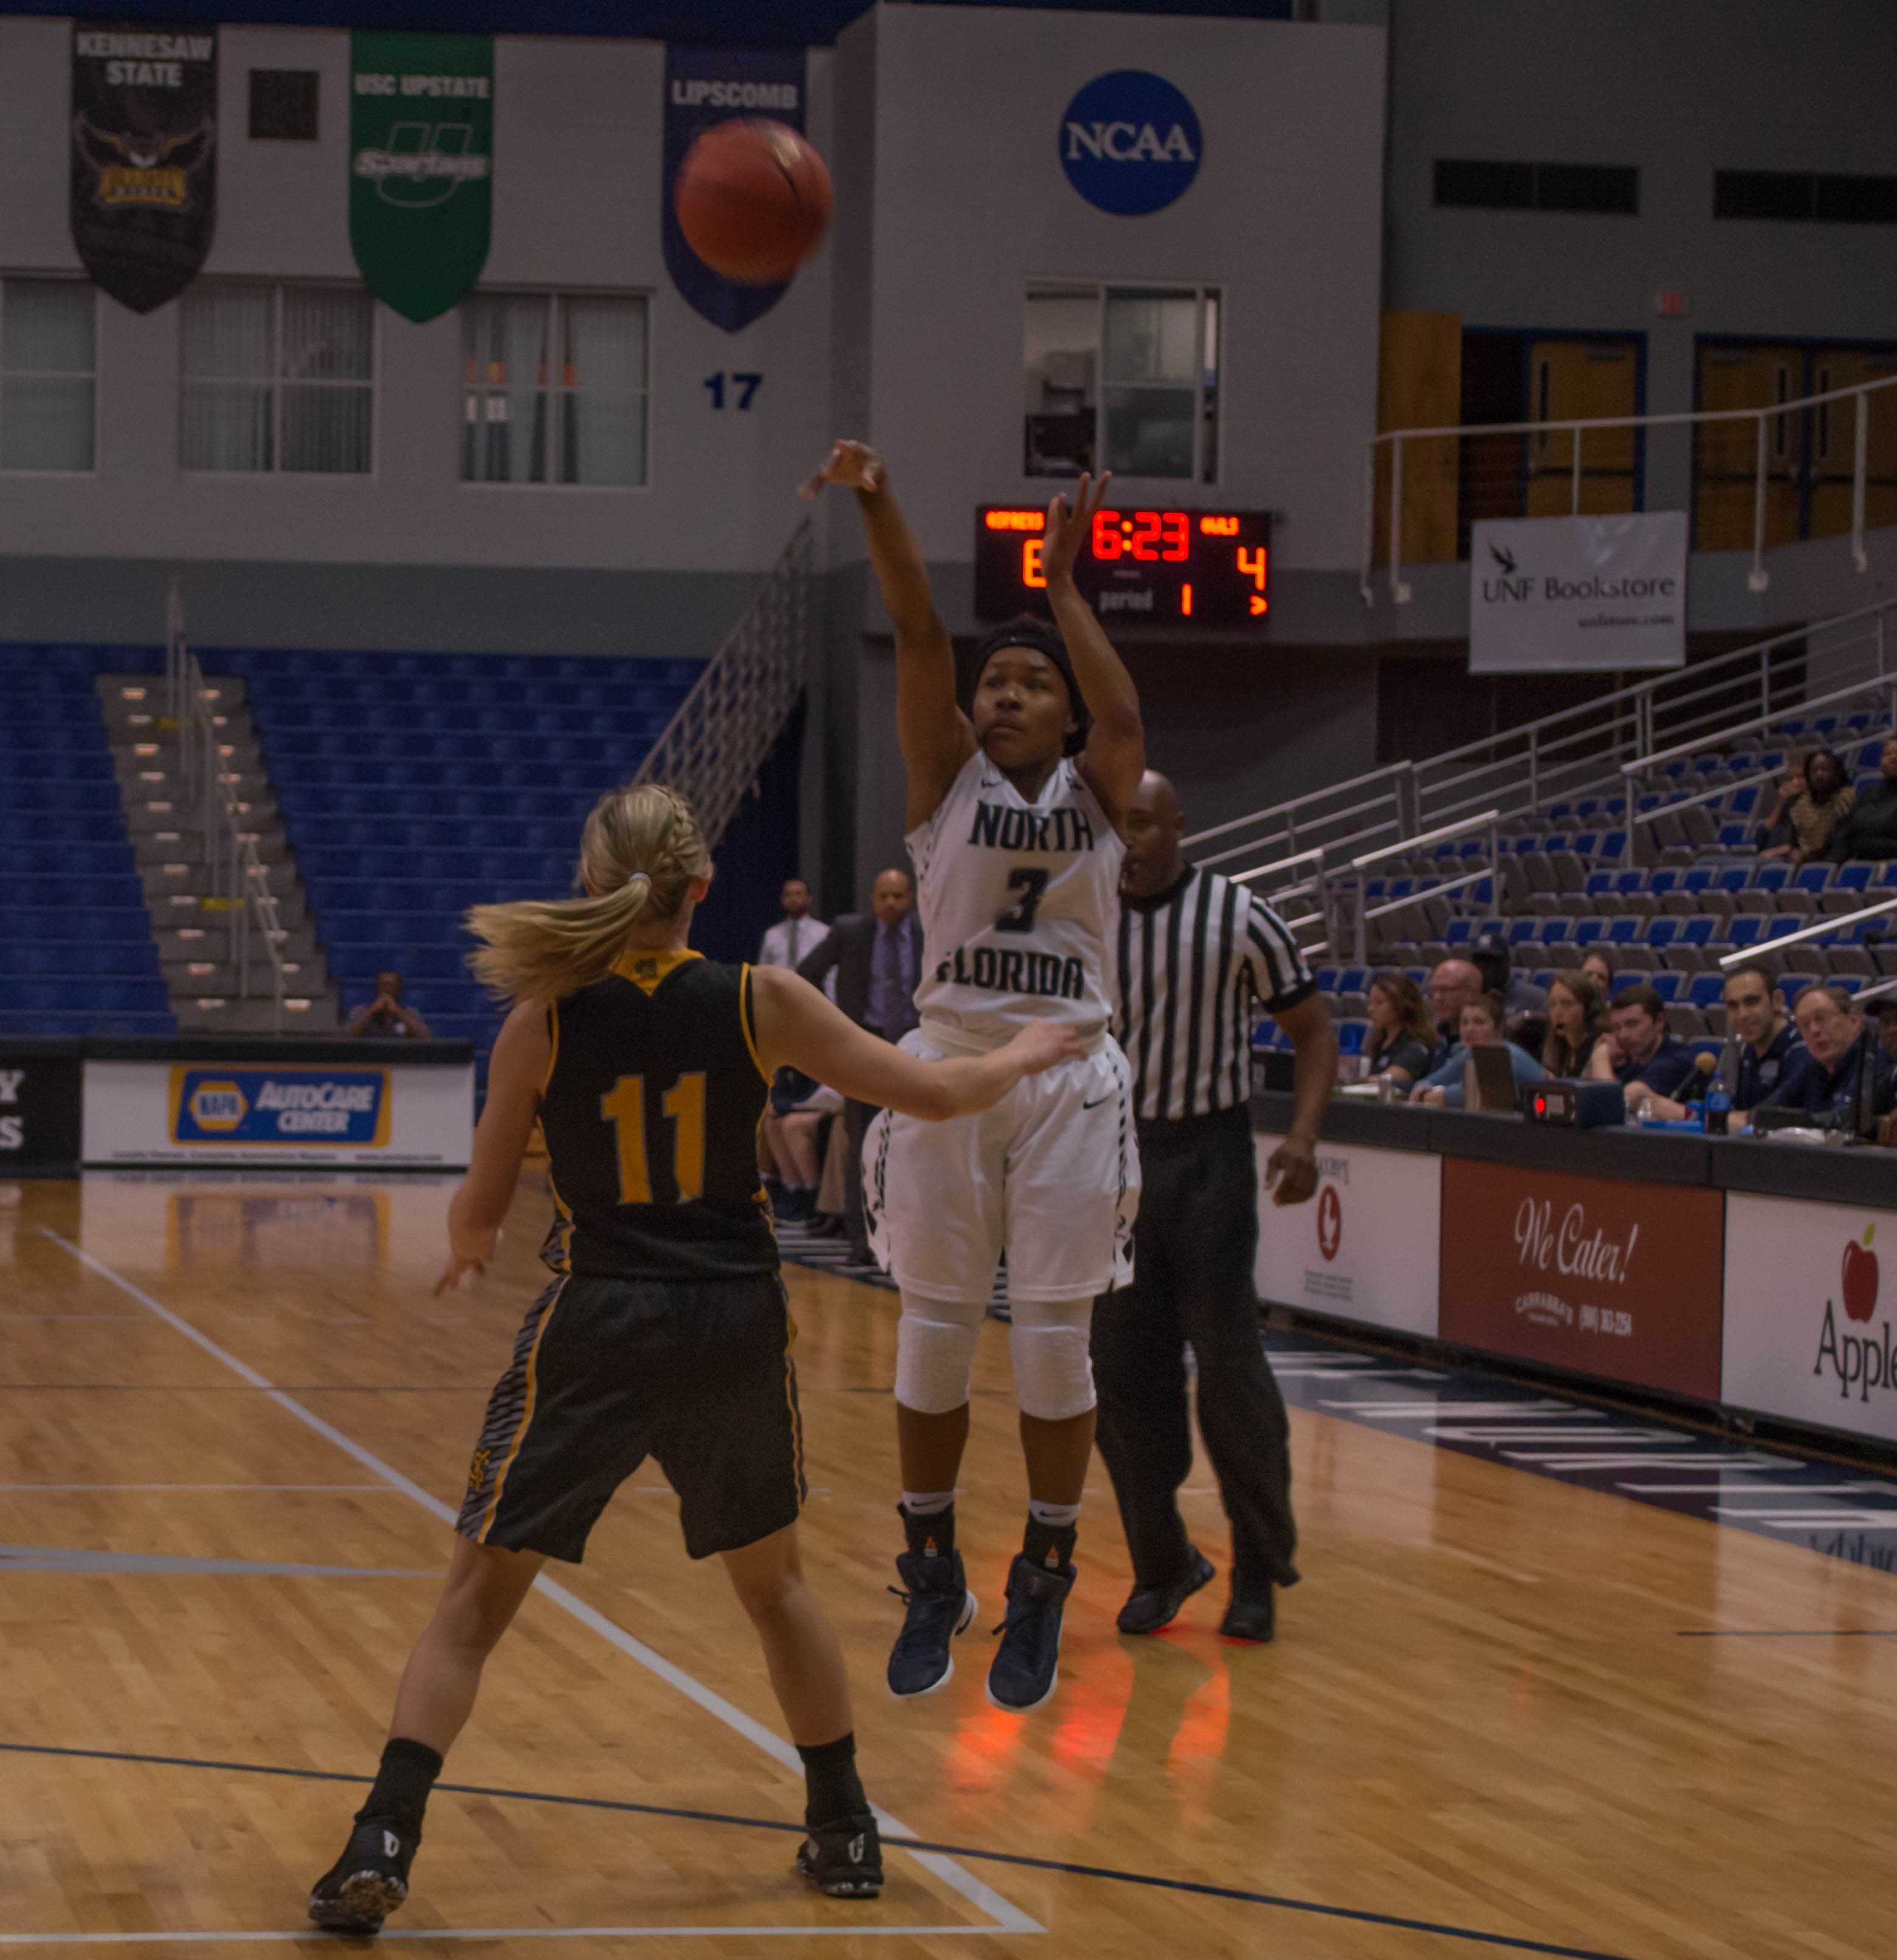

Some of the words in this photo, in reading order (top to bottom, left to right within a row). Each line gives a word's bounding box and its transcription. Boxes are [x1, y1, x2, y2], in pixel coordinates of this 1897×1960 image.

[77, 32, 213, 60] KENNESAW
[106, 60, 182, 86] STATE
[354, 73, 396, 95] USC
[399, 74, 490, 98] UPSTATE
[670, 79, 799, 109] LIPSCOMB
[1066, 121, 1195, 163] NCAA
[704, 372, 762, 409] 17
[1092, 509, 1190, 562] 6:23
[1236, 546, 1267, 591] 4
[1098, 587, 1154, 613] period
[1180, 582, 1194, 617] 1
[1483, 579, 1535, 603] UNF
[1545, 576, 1675, 602] Bookstore
[968, 800, 1093, 851] NORTH
[994, 867, 1049, 934] 3
[199, 1093, 238, 1116] NAPA
[277, 1110, 349, 1134] CENTER
[600, 1071, 706, 1205] 11
[1515, 1196, 1554, 1270] We
[1557, 1203, 1639, 1284] Cater!
[1814, 1299, 1897, 1403] Appl
